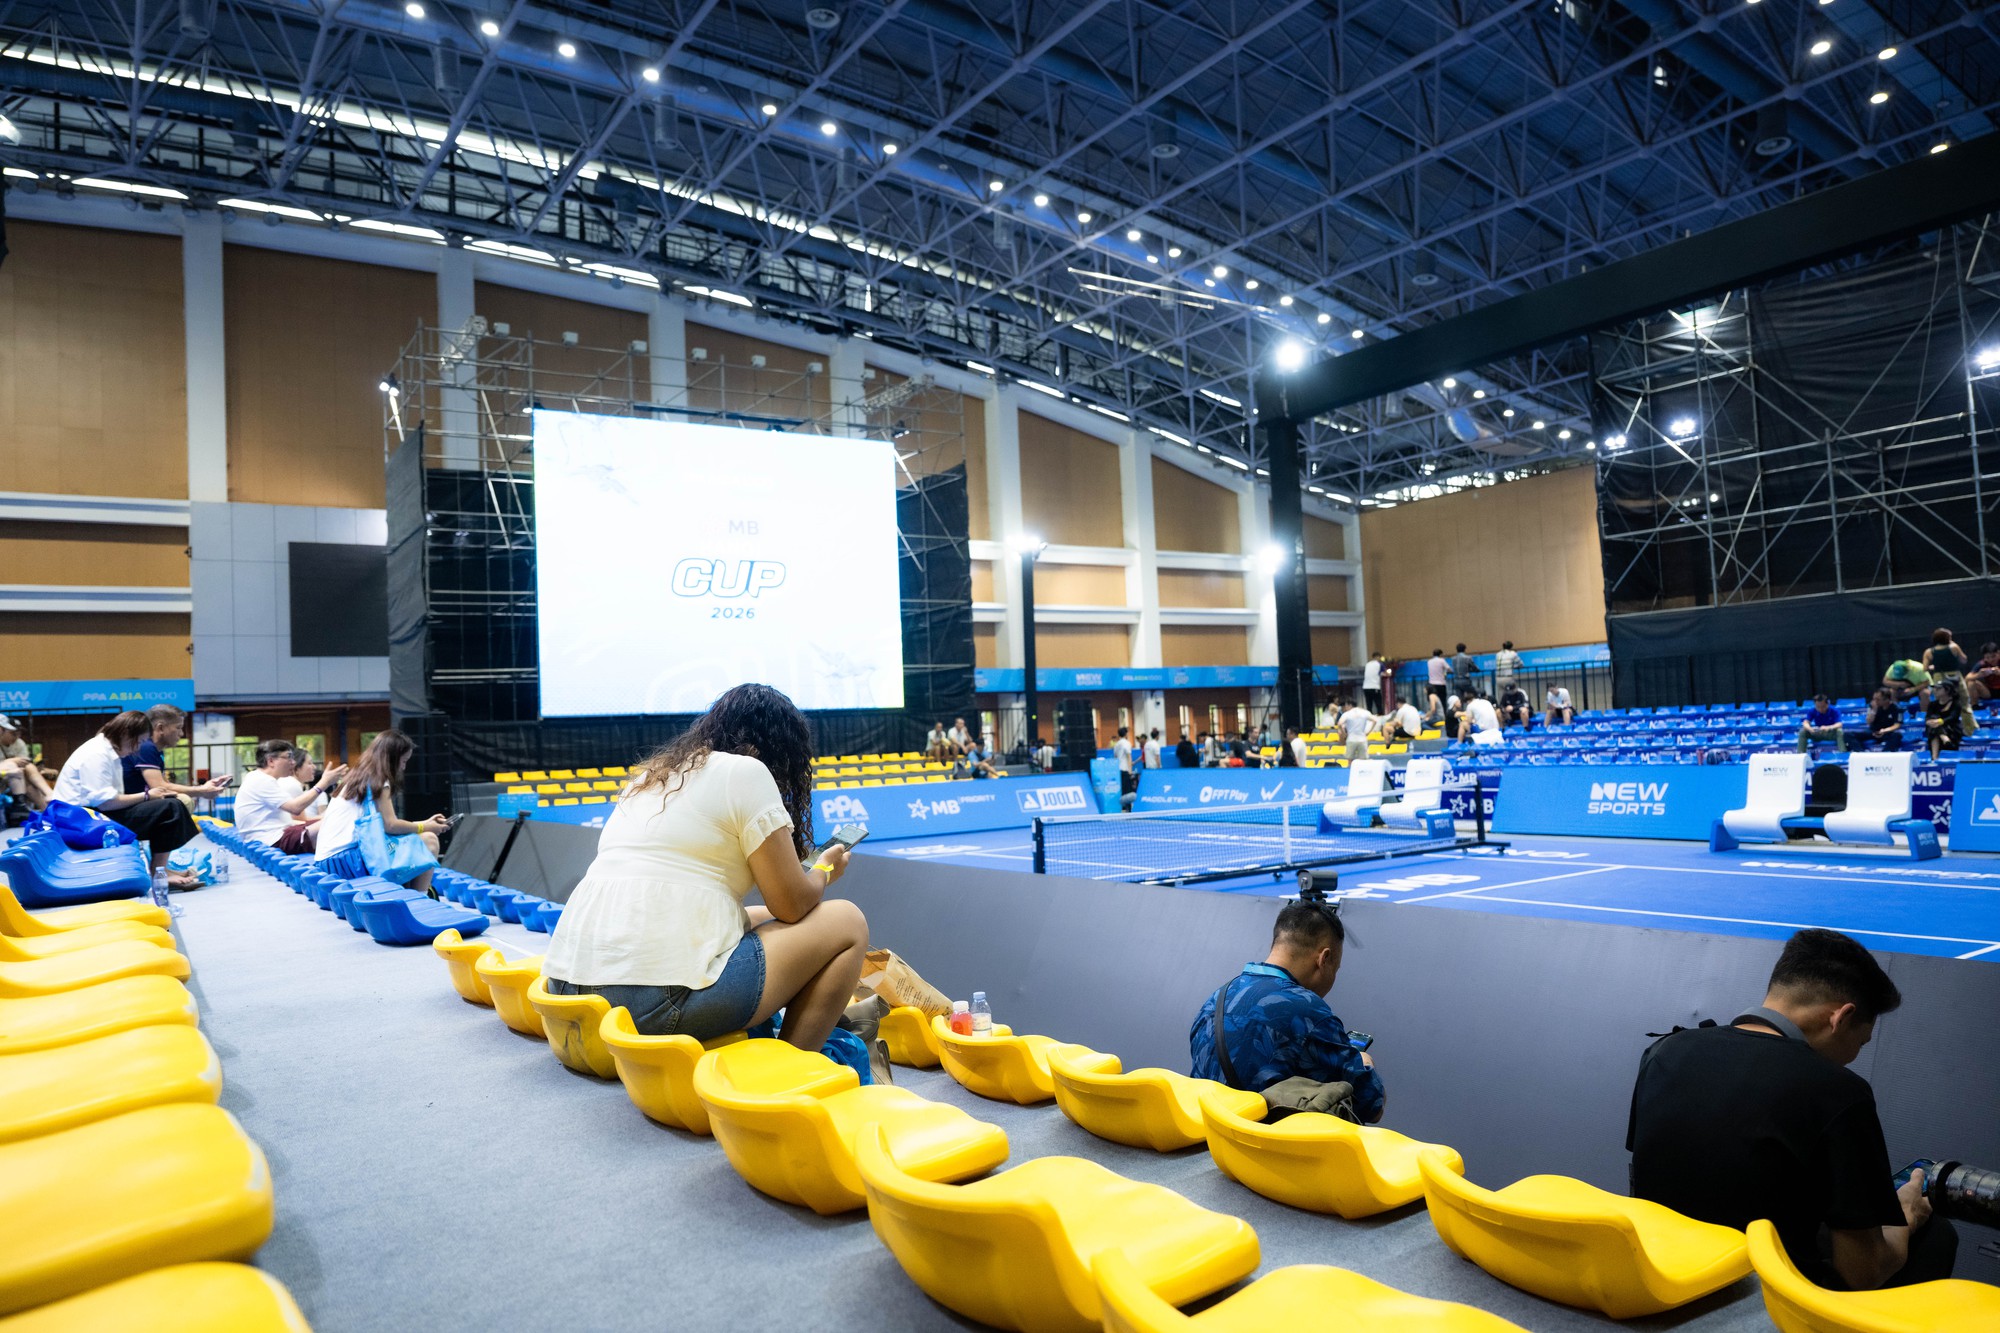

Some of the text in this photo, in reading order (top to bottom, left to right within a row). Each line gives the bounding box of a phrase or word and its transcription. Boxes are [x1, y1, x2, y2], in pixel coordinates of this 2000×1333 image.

[728, 519, 760, 536] MB
[671, 557, 787, 599] CUP
[710, 606, 756, 619] 2026
[82, 691, 177, 701] PPA ASIA 1000
[1911, 771, 1942, 787] MB
[1043, 789, 1083, 807] JOOLA
[1211, 789, 1250, 803] FPT Play
[1590, 781, 1670, 801] NEW
[821, 795, 869, 819] PPA
[930, 799, 961, 816] MB
[1140, 795, 1189, 804] PADDLETEK
[1587, 801, 1666, 816] SPORTS
